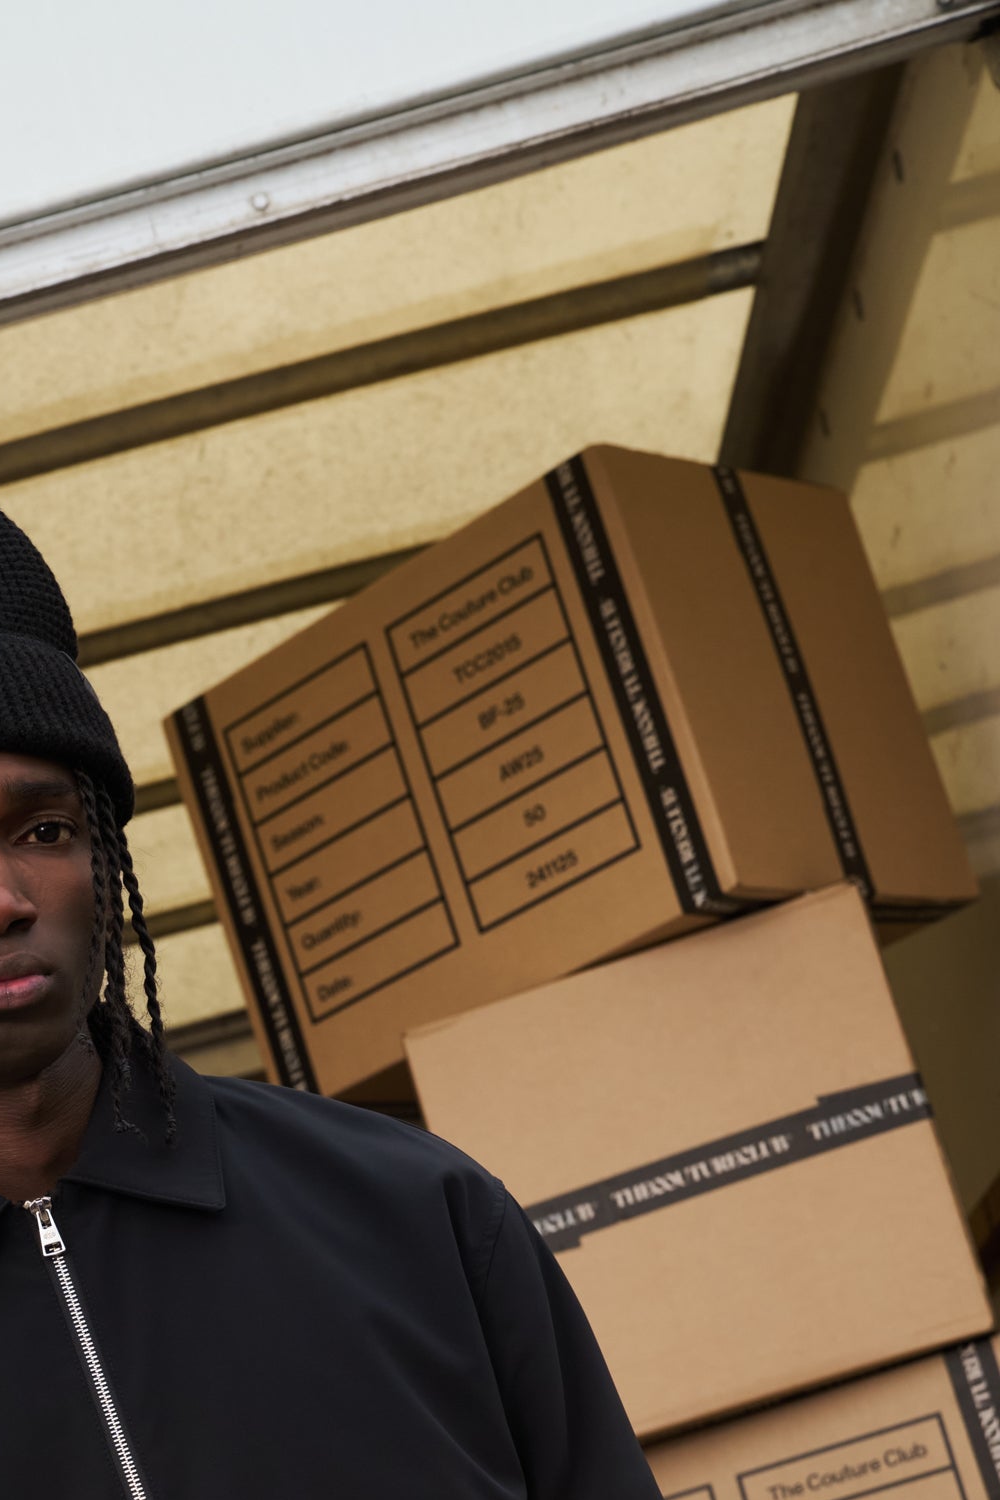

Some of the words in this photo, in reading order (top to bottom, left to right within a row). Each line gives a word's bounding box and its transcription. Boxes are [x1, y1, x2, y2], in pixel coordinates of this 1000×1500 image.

[408, 623, 438, 650] The
[438, 588, 497, 635] Couture
[498, 565, 535, 597] Club
[451, 632, 523, 684] TCC2015
[477, 691, 526, 731] BF-25
[499, 744, 545, 782] AW25
[522, 803, 547, 828] 50
[525, 849, 579, 889] 241125
[805, 1456, 881, 1492] Couture
[883, 1441, 928, 1468] Club
